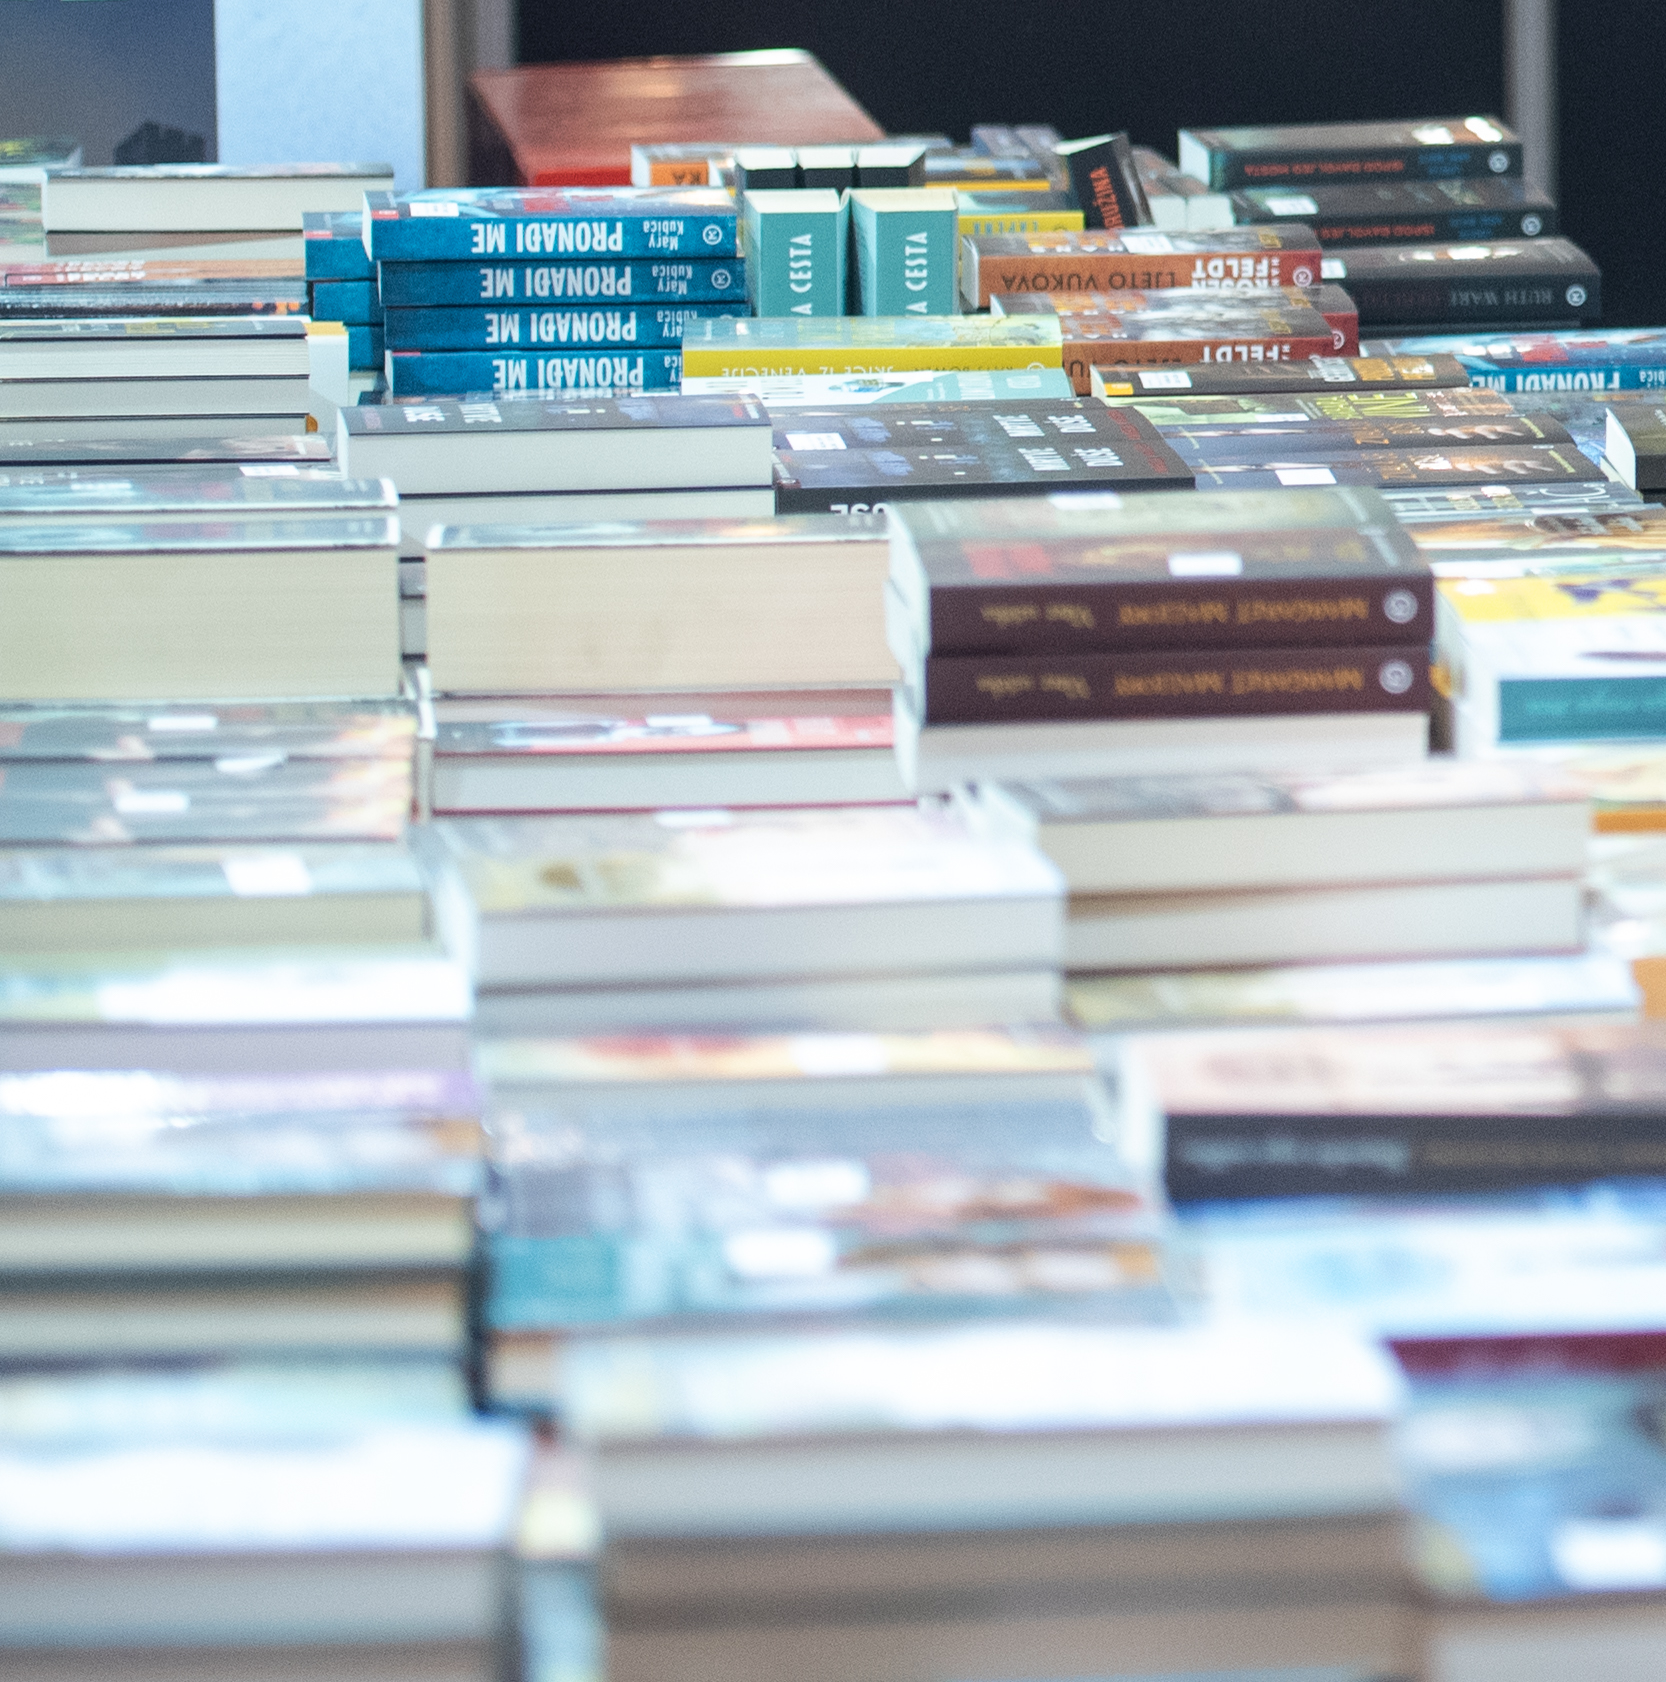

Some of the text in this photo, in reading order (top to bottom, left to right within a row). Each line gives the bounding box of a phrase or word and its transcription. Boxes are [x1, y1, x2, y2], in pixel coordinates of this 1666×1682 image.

[471, 222, 623, 255] PRONAĐI ME
[643, 220, 684, 238] Kubica
[649, 233, 680, 251] Mary
[789, 233, 812, 294] CESTA
[904, 231, 928, 292] CESTA
[1192, 257, 1270, 278] FELDT
[480, 266, 632, 298] PRONAĐI ME
[651, 264, 693, 283] Kubica
[1000, 272, 1177, 293] LJETO VUKOVA
[656, 278, 688, 296] Mary
[485, 311, 637, 343] PRONAĐI ME
[1199, 344, 1280, 364] FELDT
[492, 356, 645, 389] PRONAĐI ME
